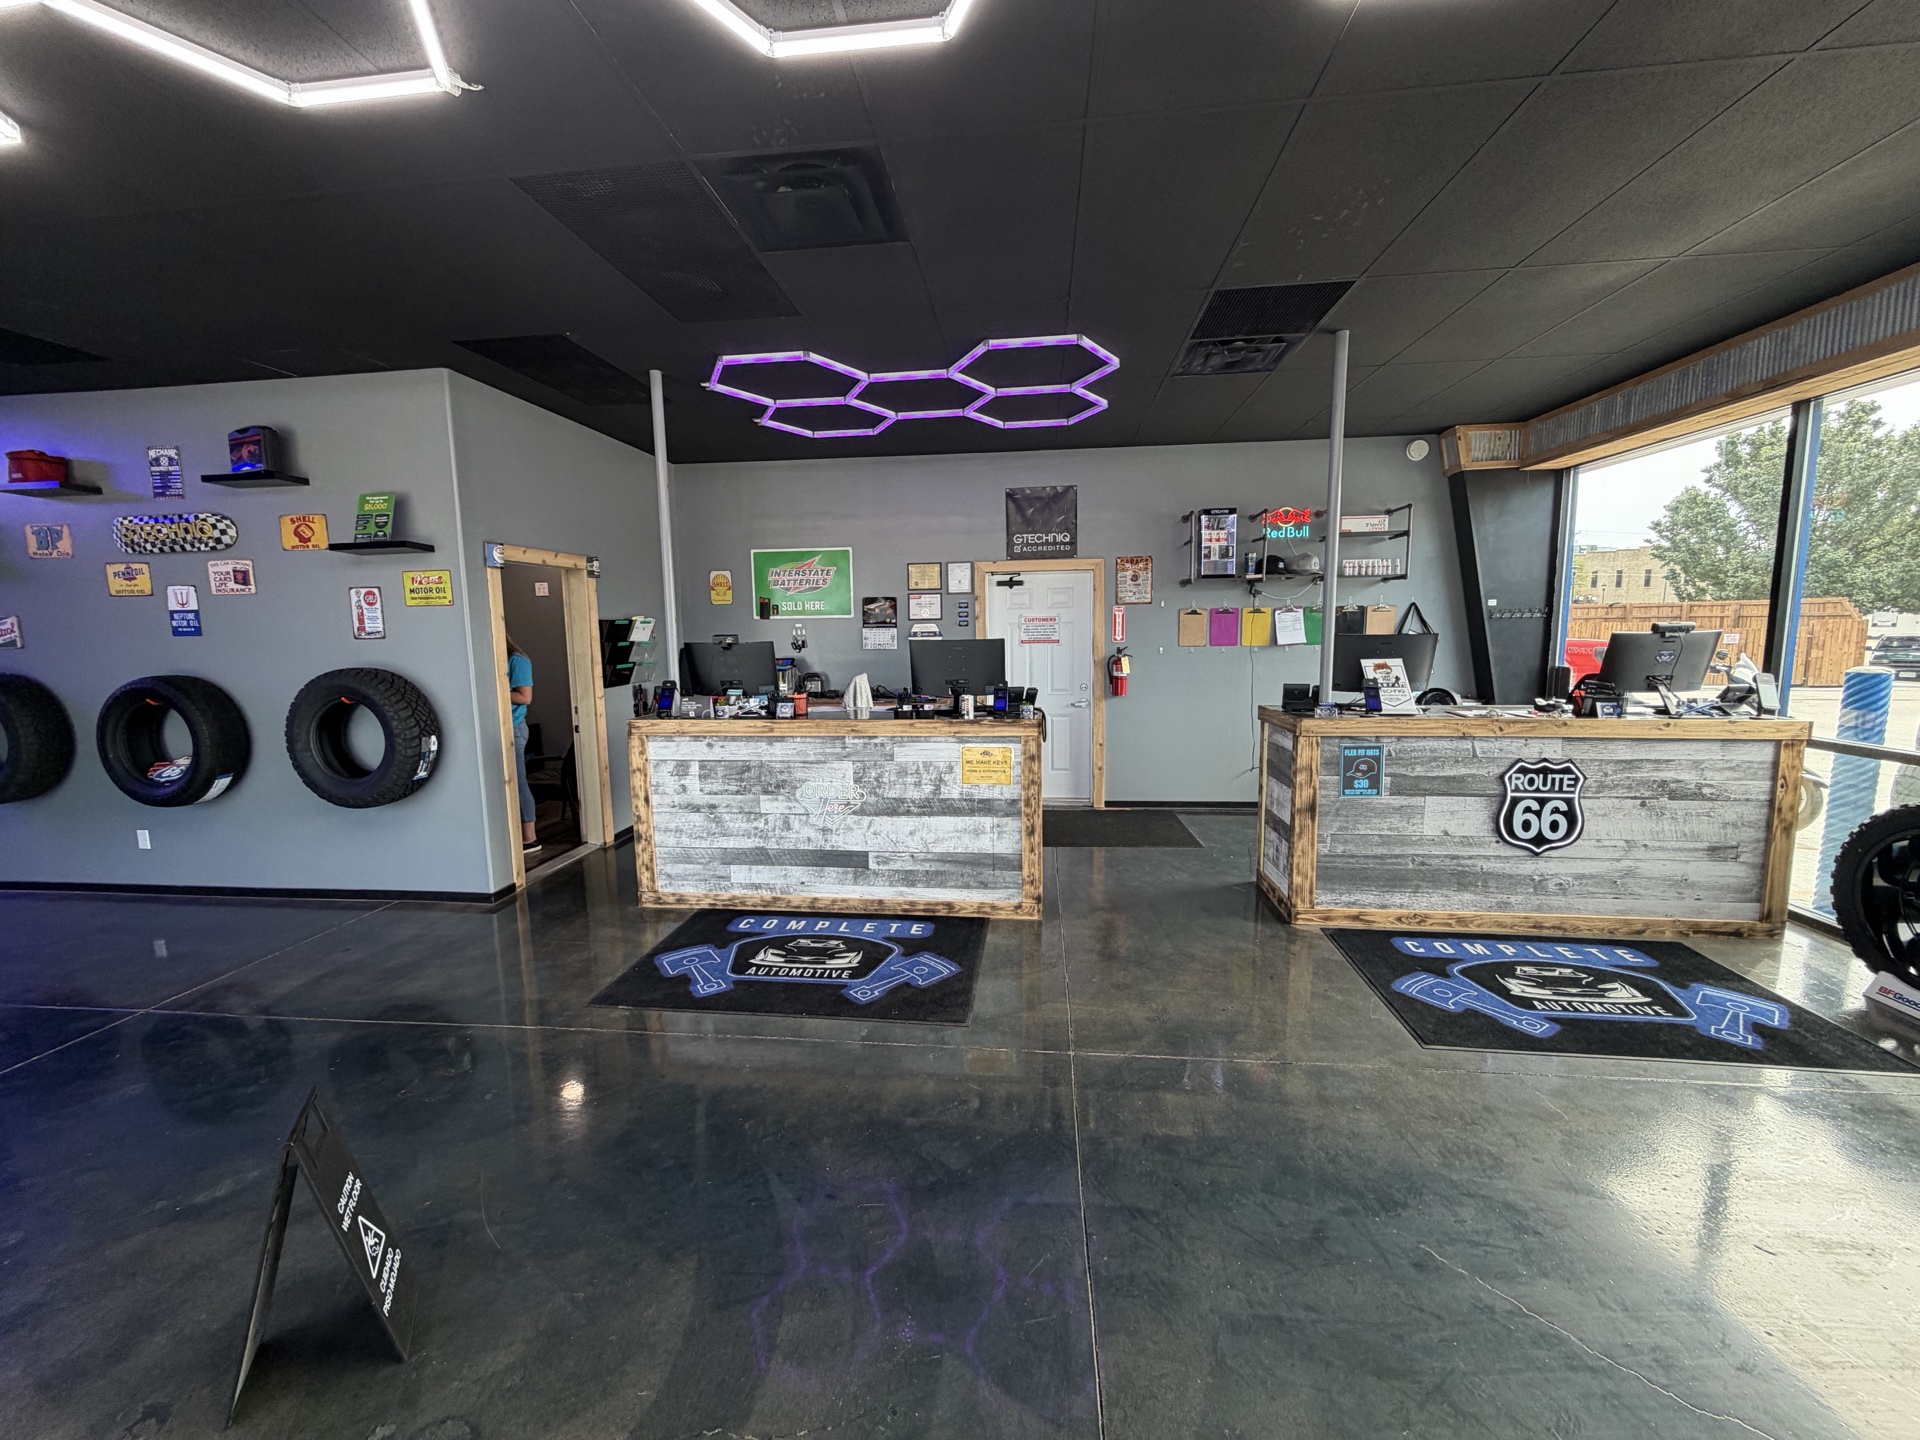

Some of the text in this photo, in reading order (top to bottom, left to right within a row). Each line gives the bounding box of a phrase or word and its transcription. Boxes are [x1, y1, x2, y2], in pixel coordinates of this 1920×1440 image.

[149, 449, 178, 460] MECHANIC
[290, 516, 315, 524] SHELL
[32, 527, 63, 550] BP
[120, 520, 212, 542] GTECHNIQ
[1013, 532, 1070, 544] GTECHNIQ
[1263, 526, 1309, 538] Red Bull
[113, 568, 145, 579] PENNZOIL
[770, 568, 833, 577] INTERSTATE
[772, 578, 828, 587] BATTERIES
[782, 601, 825, 611] SOLD HERE
[1354, 780, 1369, 789] $30
[1510, 774, 1576, 791] ROUTE
[805, 784, 860, 799] ORDER
[812, 799, 854, 826] Here
[1513, 799, 1568, 840] 66
[738, 918, 926, 935] COMPLETE
[1403, 940, 1645, 962] COMPLETE
[745, 966, 854, 979] AUTOMOTIVE
[1533, 1000, 1673, 1016] AUTOMOTIVE
[338, 1172, 354, 1214] CAUTION
[341, 1178, 362, 1232] WET FLOOR
[380, 1247, 394, 1293] CUIDADO
[383, 1248, 401, 1317] PISO MOJADO
